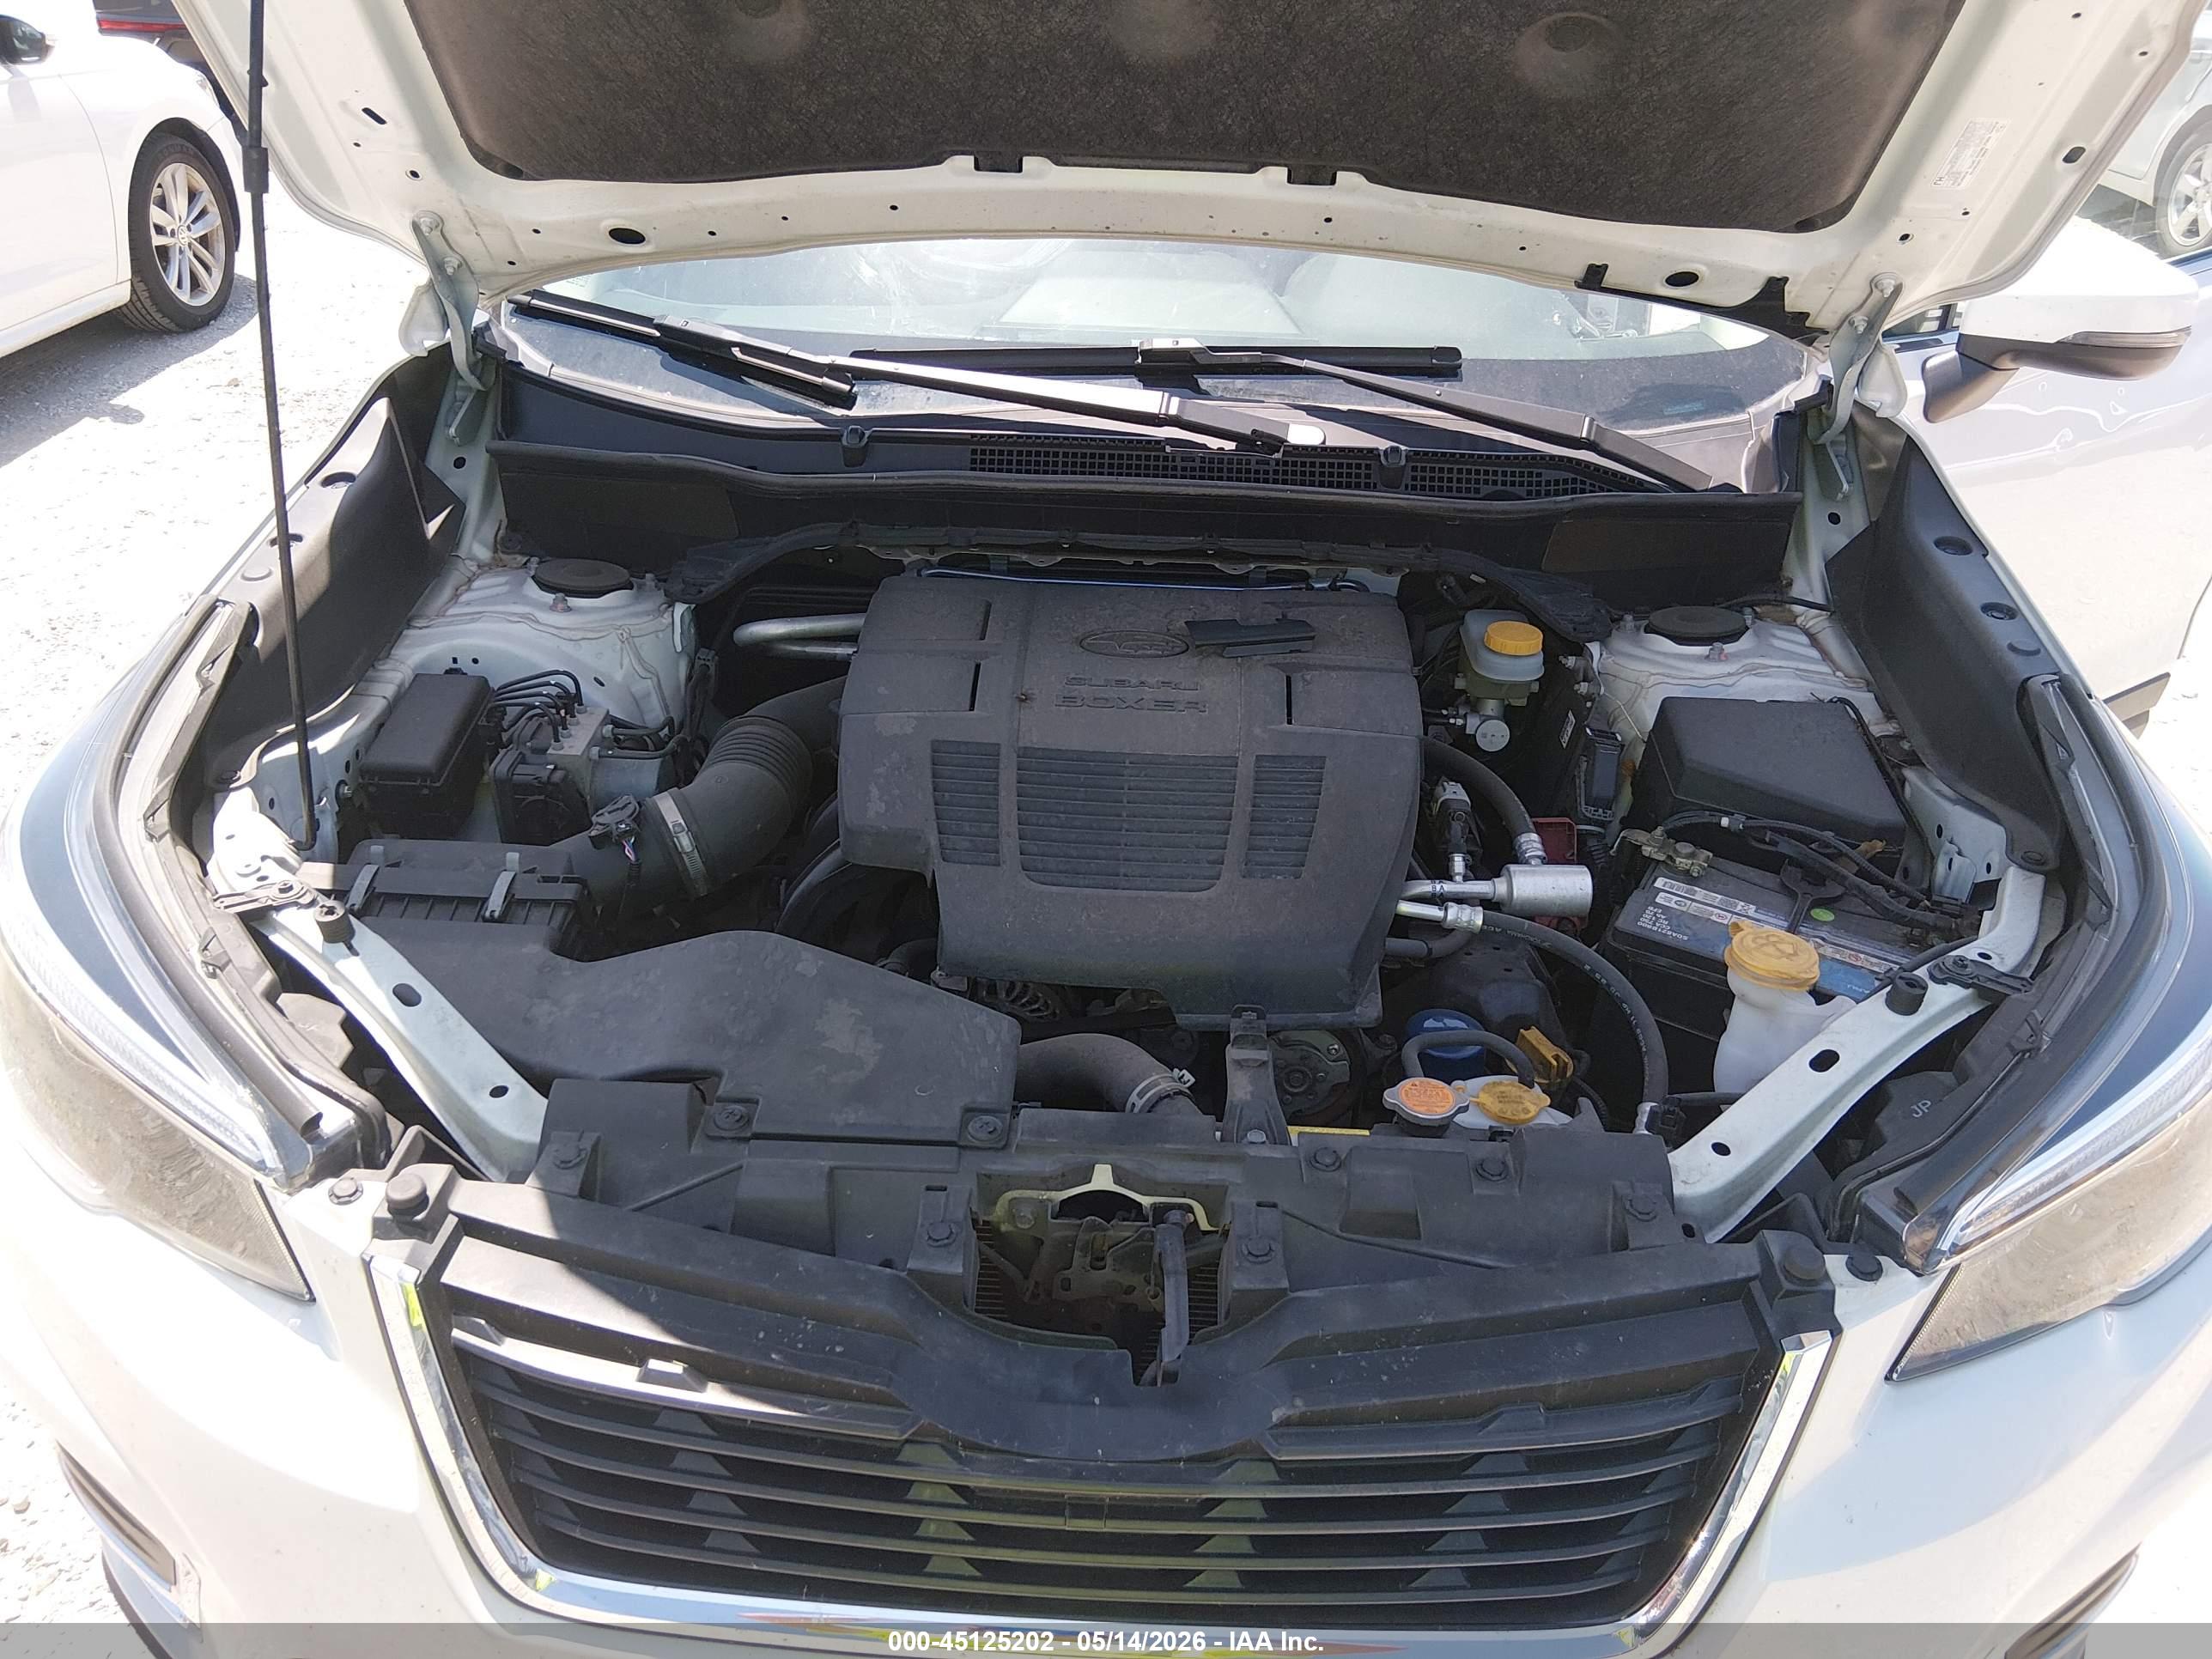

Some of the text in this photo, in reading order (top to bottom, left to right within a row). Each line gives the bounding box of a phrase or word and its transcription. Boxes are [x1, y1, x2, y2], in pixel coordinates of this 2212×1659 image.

[1064, 676, 1200, 691] SUBARU
[1054, 693, 1208, 714] BOXER
[1911, 1100, 1931, 1117] JP
